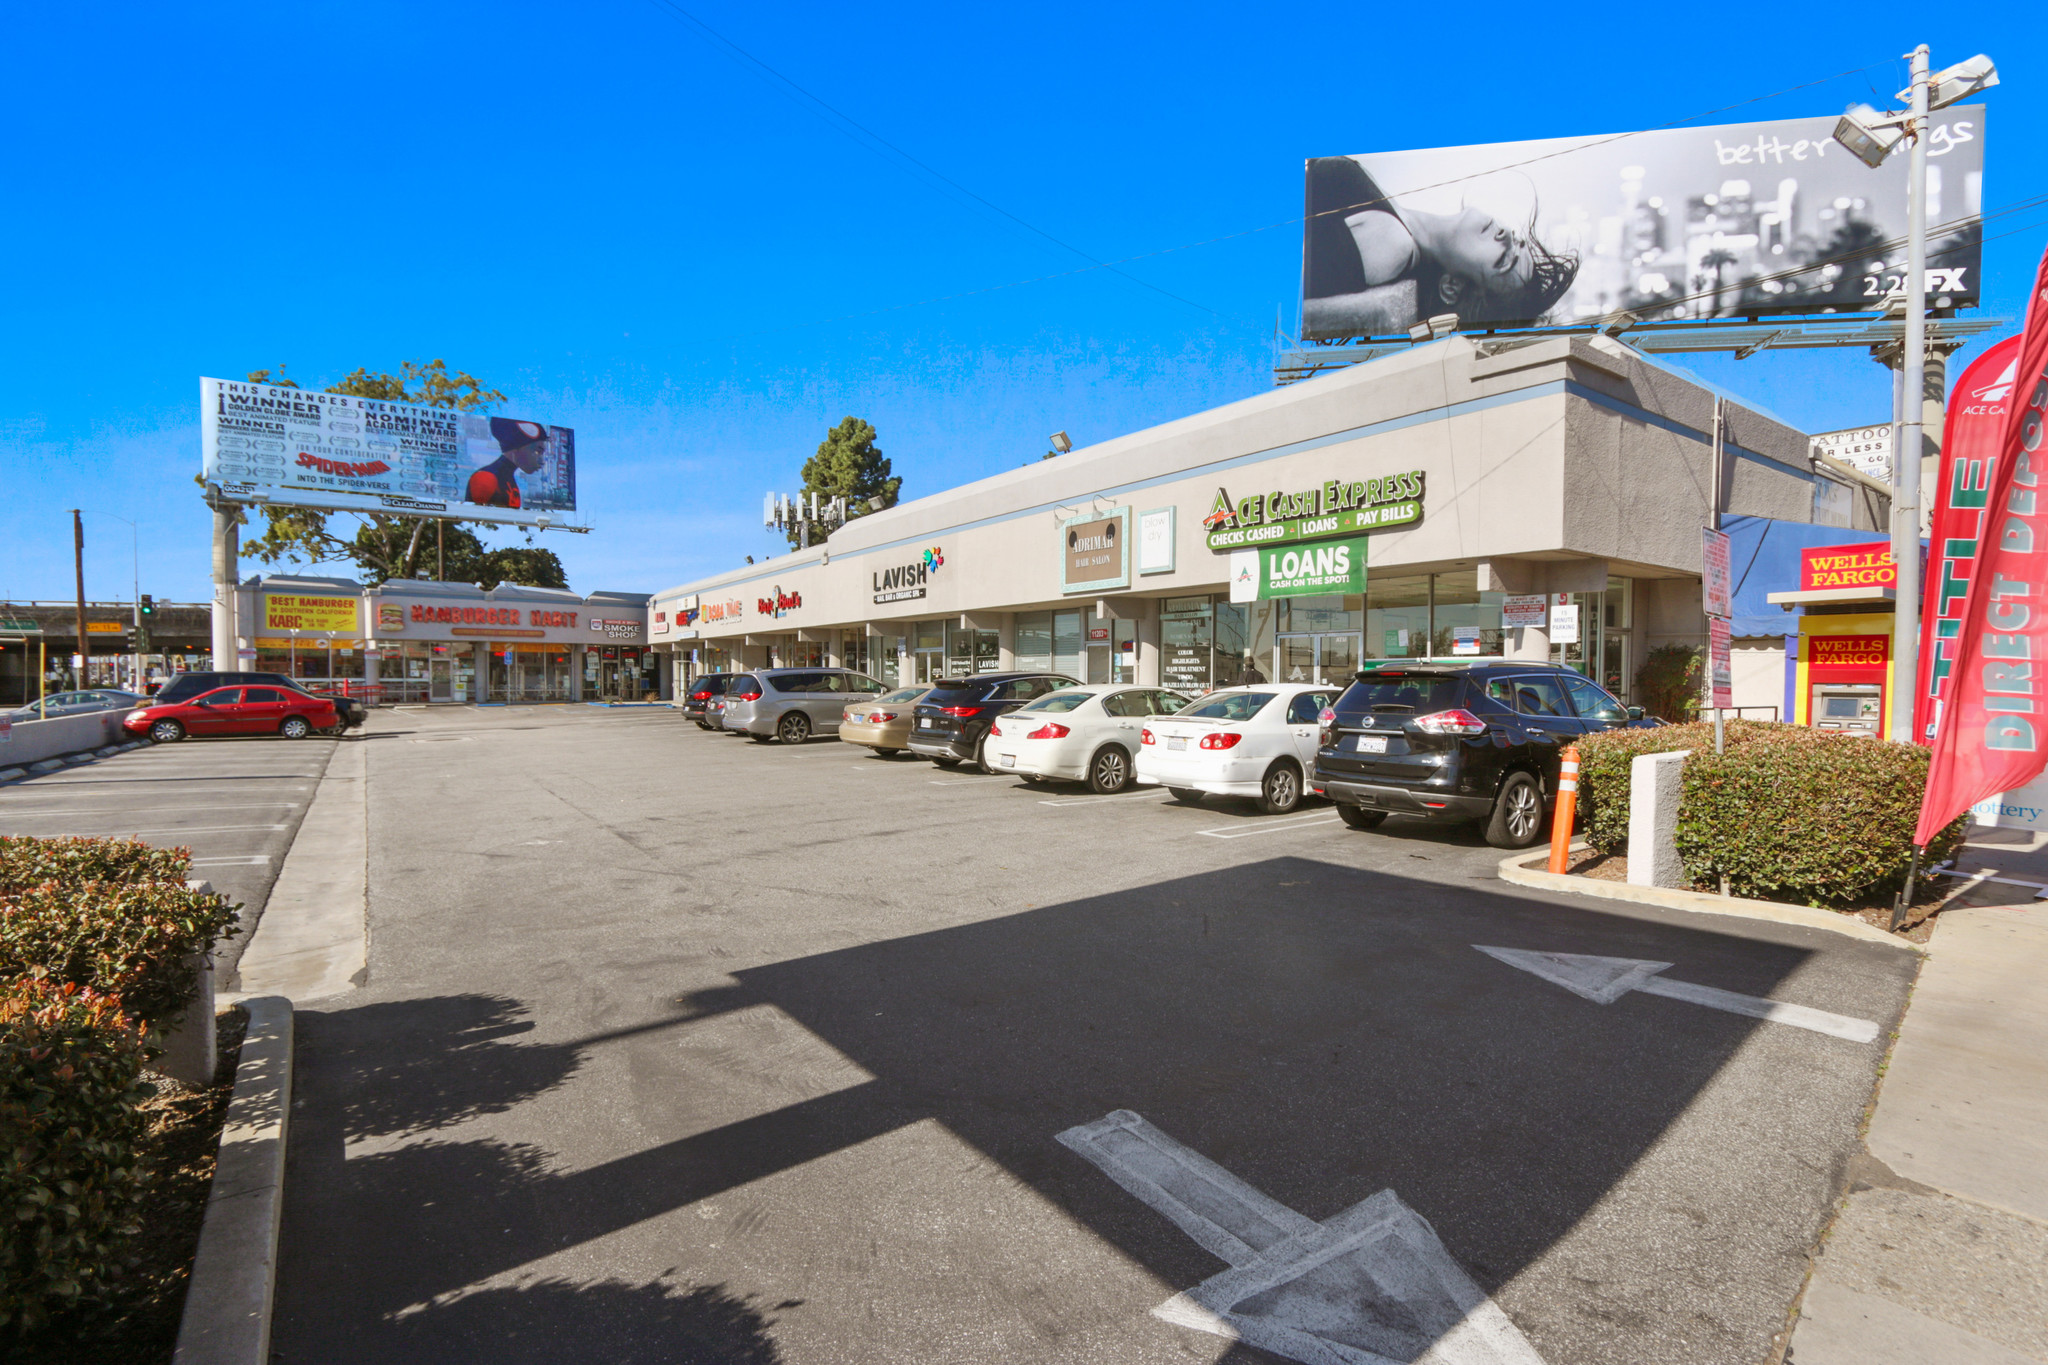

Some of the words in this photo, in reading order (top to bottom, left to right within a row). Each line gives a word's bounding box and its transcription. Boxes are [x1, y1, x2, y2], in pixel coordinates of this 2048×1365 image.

[1714, 135, 1836, 165] better
[1924, 267, 1967, 292] FX
[218, 382, 258, 395] THIS
[269, 389, 348, 407] CHANGES
[358, 401, 457, 421] EVERYTHING
[228, 393, 320, 413] WINNER
[1962, 405, 1987, 415] ACE
[228, 403, 262, 412] GOLDEN
[264, 407, 290, 416] GLOBE
[293, 411, 321, 420] AWARD
[250, 413, 288, 423] ANIMATED
[289, 418, 321, 427] FEATURE
[218, 417, 285, 430] WINNER
[365, 412, 457, 431] NOMINEE
[366, 420, 416, 433] ACADEMY
[421, 426, 457, 438] AWARD
[400, 438, 457, 450] WINNER
[1811, 427, 1889, 446] ATTOO
[1845, 442, 1883, 454] LESS
[295, 452, 391, 477] SPIDER-MAN
[297, 475, 317, 483] INTO
[338, 478, 391, 490] SPIDER-VERSE
[1265, 489, 1317, 520] CASH
[1323, 470, 1423, 511] EXPRESS
[1210, 531, 1244, 547] CHECKS
[1246, 525, 1284, 542] CASHED
[1302, 516, 1338, 535] LOANS
[1356, 510, 1379, 526] PAY
[1380, 504, 1414, 521] BILLS
[1072, 534, 1114, 553] ADRIMAR
[1076, 558, 1089, 568] HAIR
[1092, 554, 1110, 566] SALON
[1270, 545, 1350, 580] LOANS
[1809, 552, 1895, 571] WELLS
[873, 562, 927, 592] LAVISH
[1270, 579, 1291, 589] CASH
[1292, 578, 1305, 587] ON
[1307, 576, 1323, 585] THE
[1324, 574, 1350, 584] SPOT!
[1811, 568, 1895, 587] FARGO
[271, 596, 295, 606] BEST
[300, 597, 354, 608] HAMBURGER
[269, 614, 302, 628] KABC
[410, 604, 521, 625] HAMBURGER
[530, 609, 578, 628] HABIT
[604, 624, 641, 632] SMOKE
[1814, 639, 1884, 652] WELLS
[979, 660, 999, 668] LAVISH
[1815, 653, 1883, 665] FARGO
[1981, 572, 2036, 751] DIRECT
